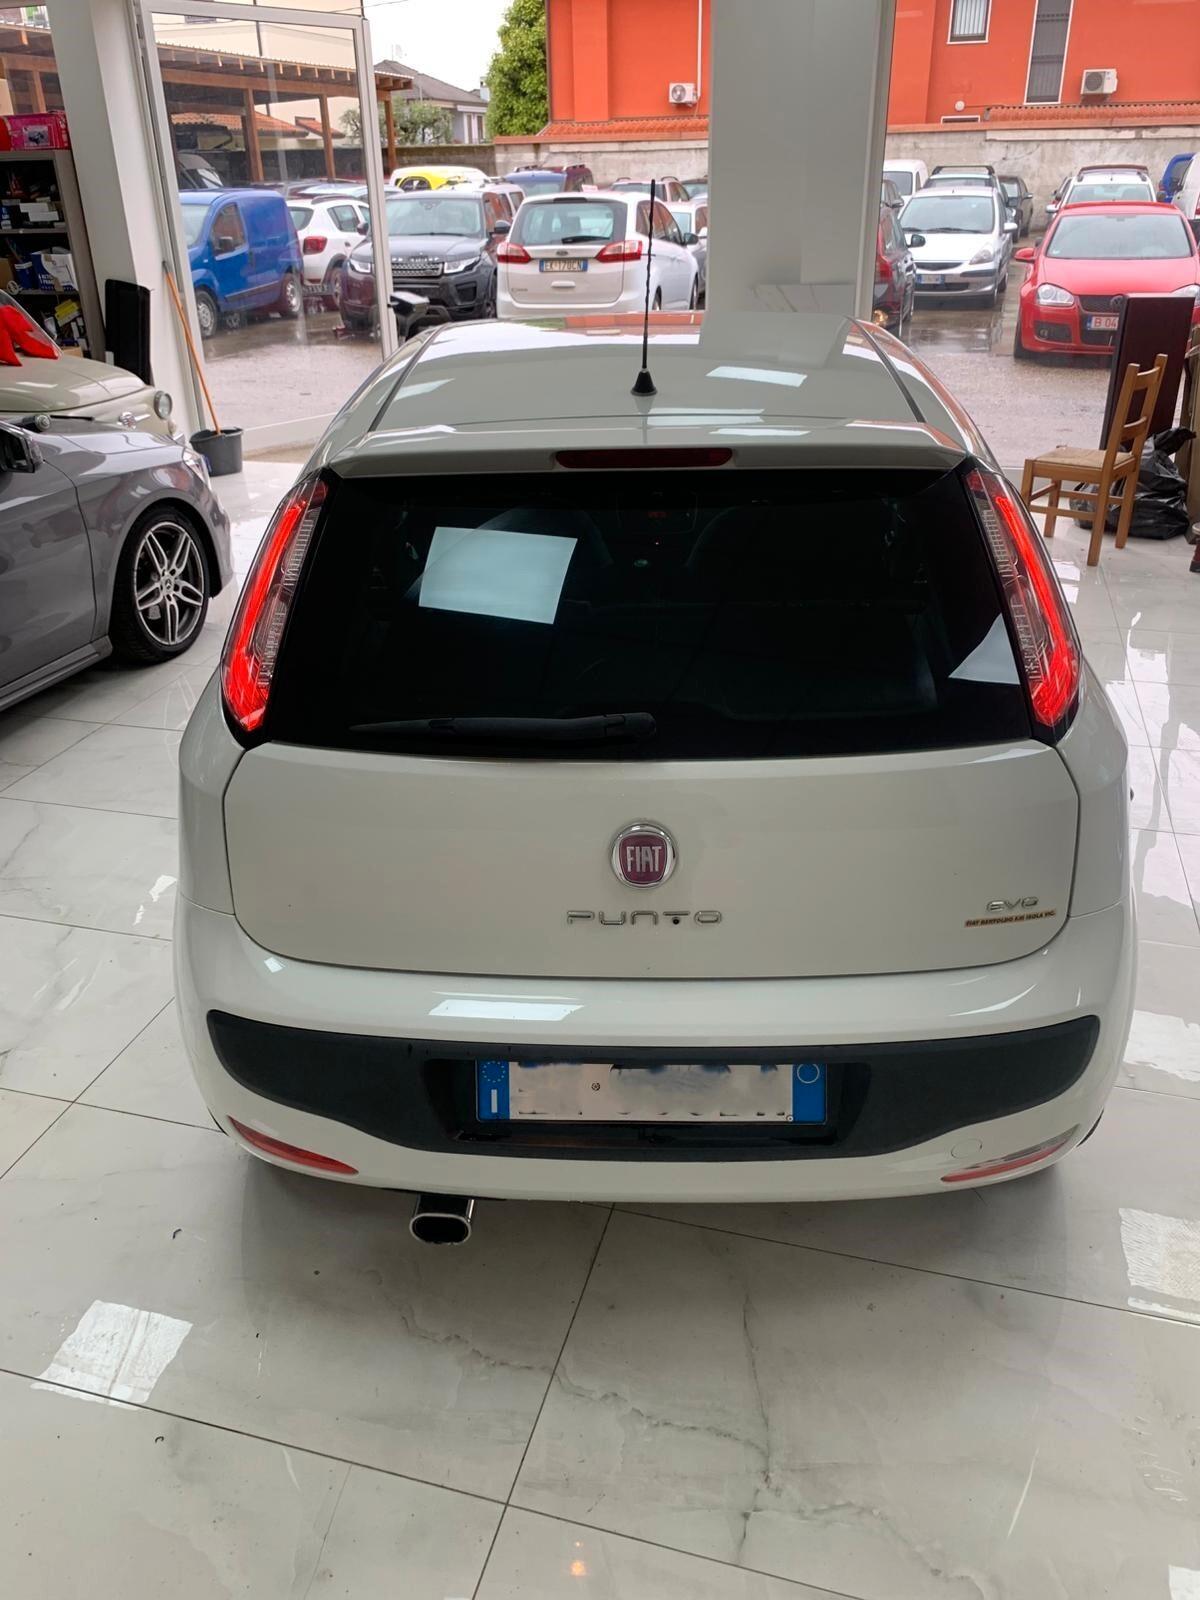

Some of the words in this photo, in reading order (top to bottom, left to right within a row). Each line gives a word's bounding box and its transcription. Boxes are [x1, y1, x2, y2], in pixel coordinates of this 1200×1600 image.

[1094, 318, 1102, 327] B
[626, 844, 662, 873] FIAT
[986, 896, 1039, 912] EVO
[566, 909, 723, 927] PUNTO
